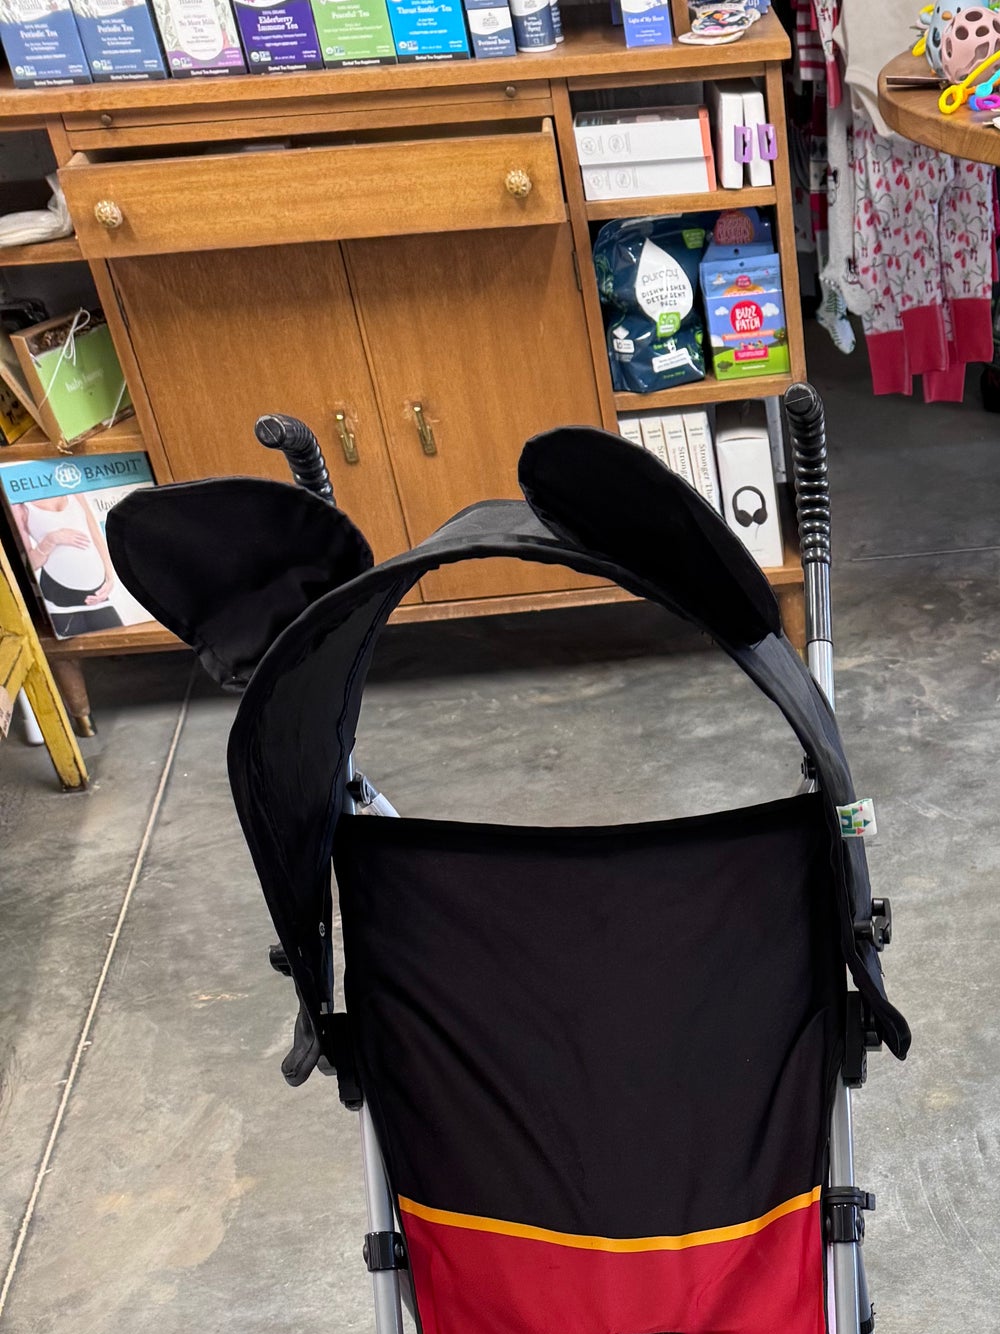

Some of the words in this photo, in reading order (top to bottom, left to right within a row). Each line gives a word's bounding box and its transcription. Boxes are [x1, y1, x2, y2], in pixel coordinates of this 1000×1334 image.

[258, 16, 293, 24] Elderberry
[735, 305, 757, 320] BUZZ
[735, 316, 760, 331] PATCH
[678, 446, 689, 479] Stronge
[699, 443, 711, 481] Stronger
[10, 474, 54, 493] BELLY
